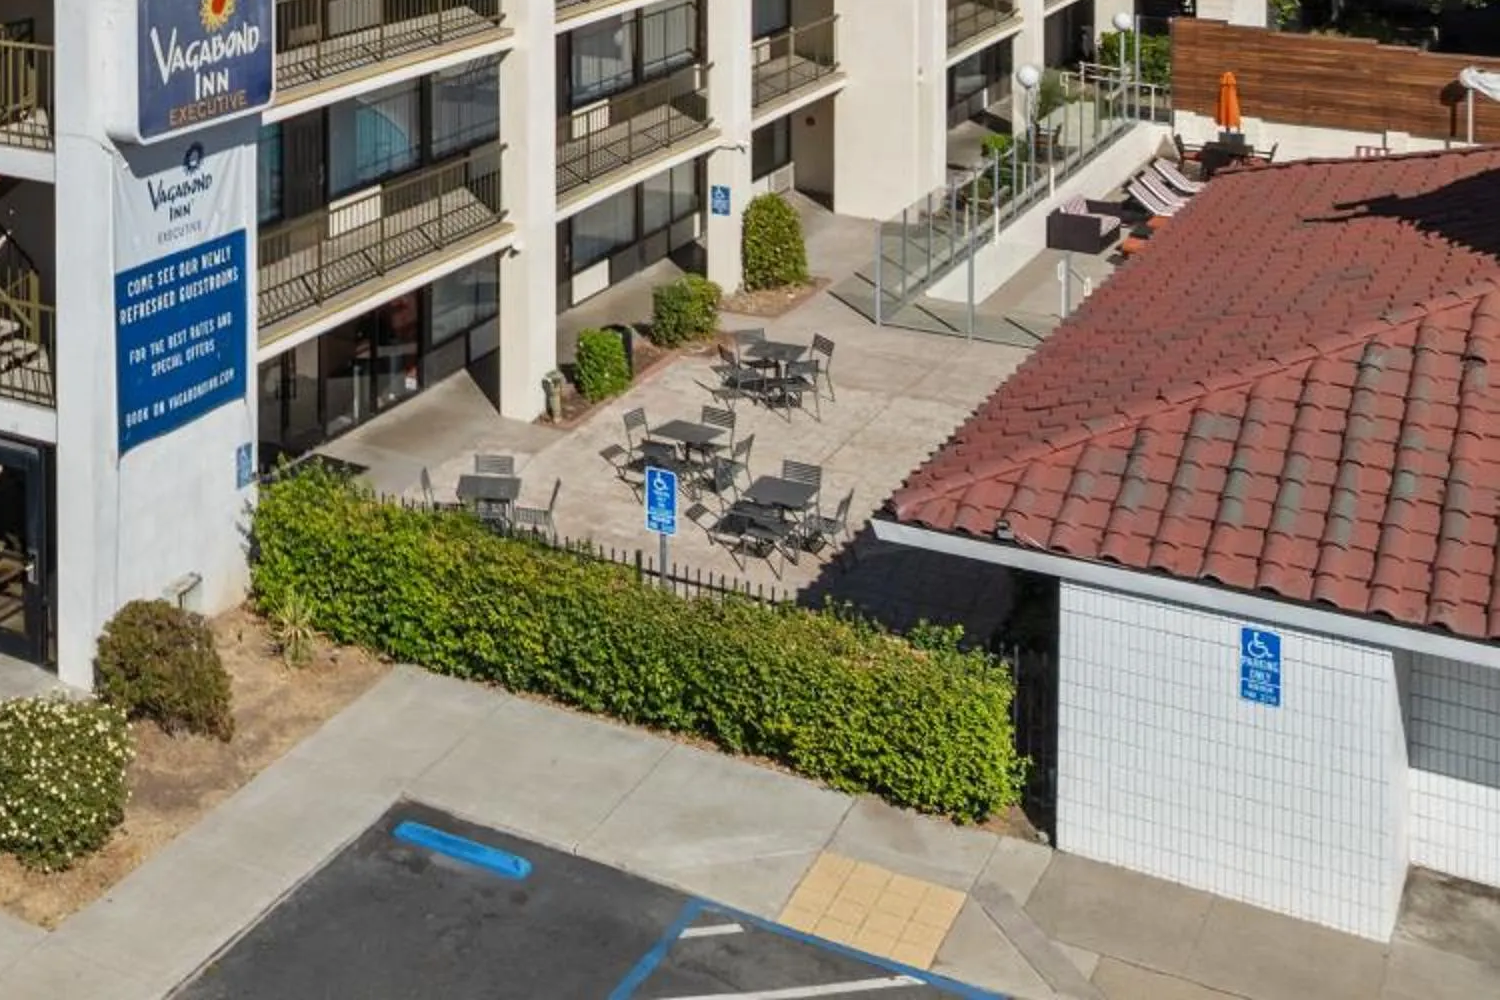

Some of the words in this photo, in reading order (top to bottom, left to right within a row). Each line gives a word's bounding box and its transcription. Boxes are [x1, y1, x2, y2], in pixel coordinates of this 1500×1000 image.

[150, 21, 260, 86] VAGABOND
[195, 68, 229, 101] INN
[169, 88, 247, 127] EXECUTIVE
[147, 173, 213, 212] VAGABOND
[169, 203, 191, 222] INN
[127, 273, 154, 298] COME
[157, 264, 175, 286] SEE
[178, 256, 199, 279] OUR
[201, 245, 231, 269] NEWLY
[118, 290, 176, 326] REFRESHED
[179, 264, 239, 303] GUESTROOMS
[128, 346, 147, 366] FOR
[149, 338, 165, 356] THE
[167, 327, 187, 350] BEST
[189, 317, 215, 340] RATES
[216, 310, 232, 329] AND
[151, 352, 184, 378] SPECIAL
[185, 338, 215, 362] OFFERS
[125, 406, 149, 429] BOOK
[152, 400, 165, 418] ON
